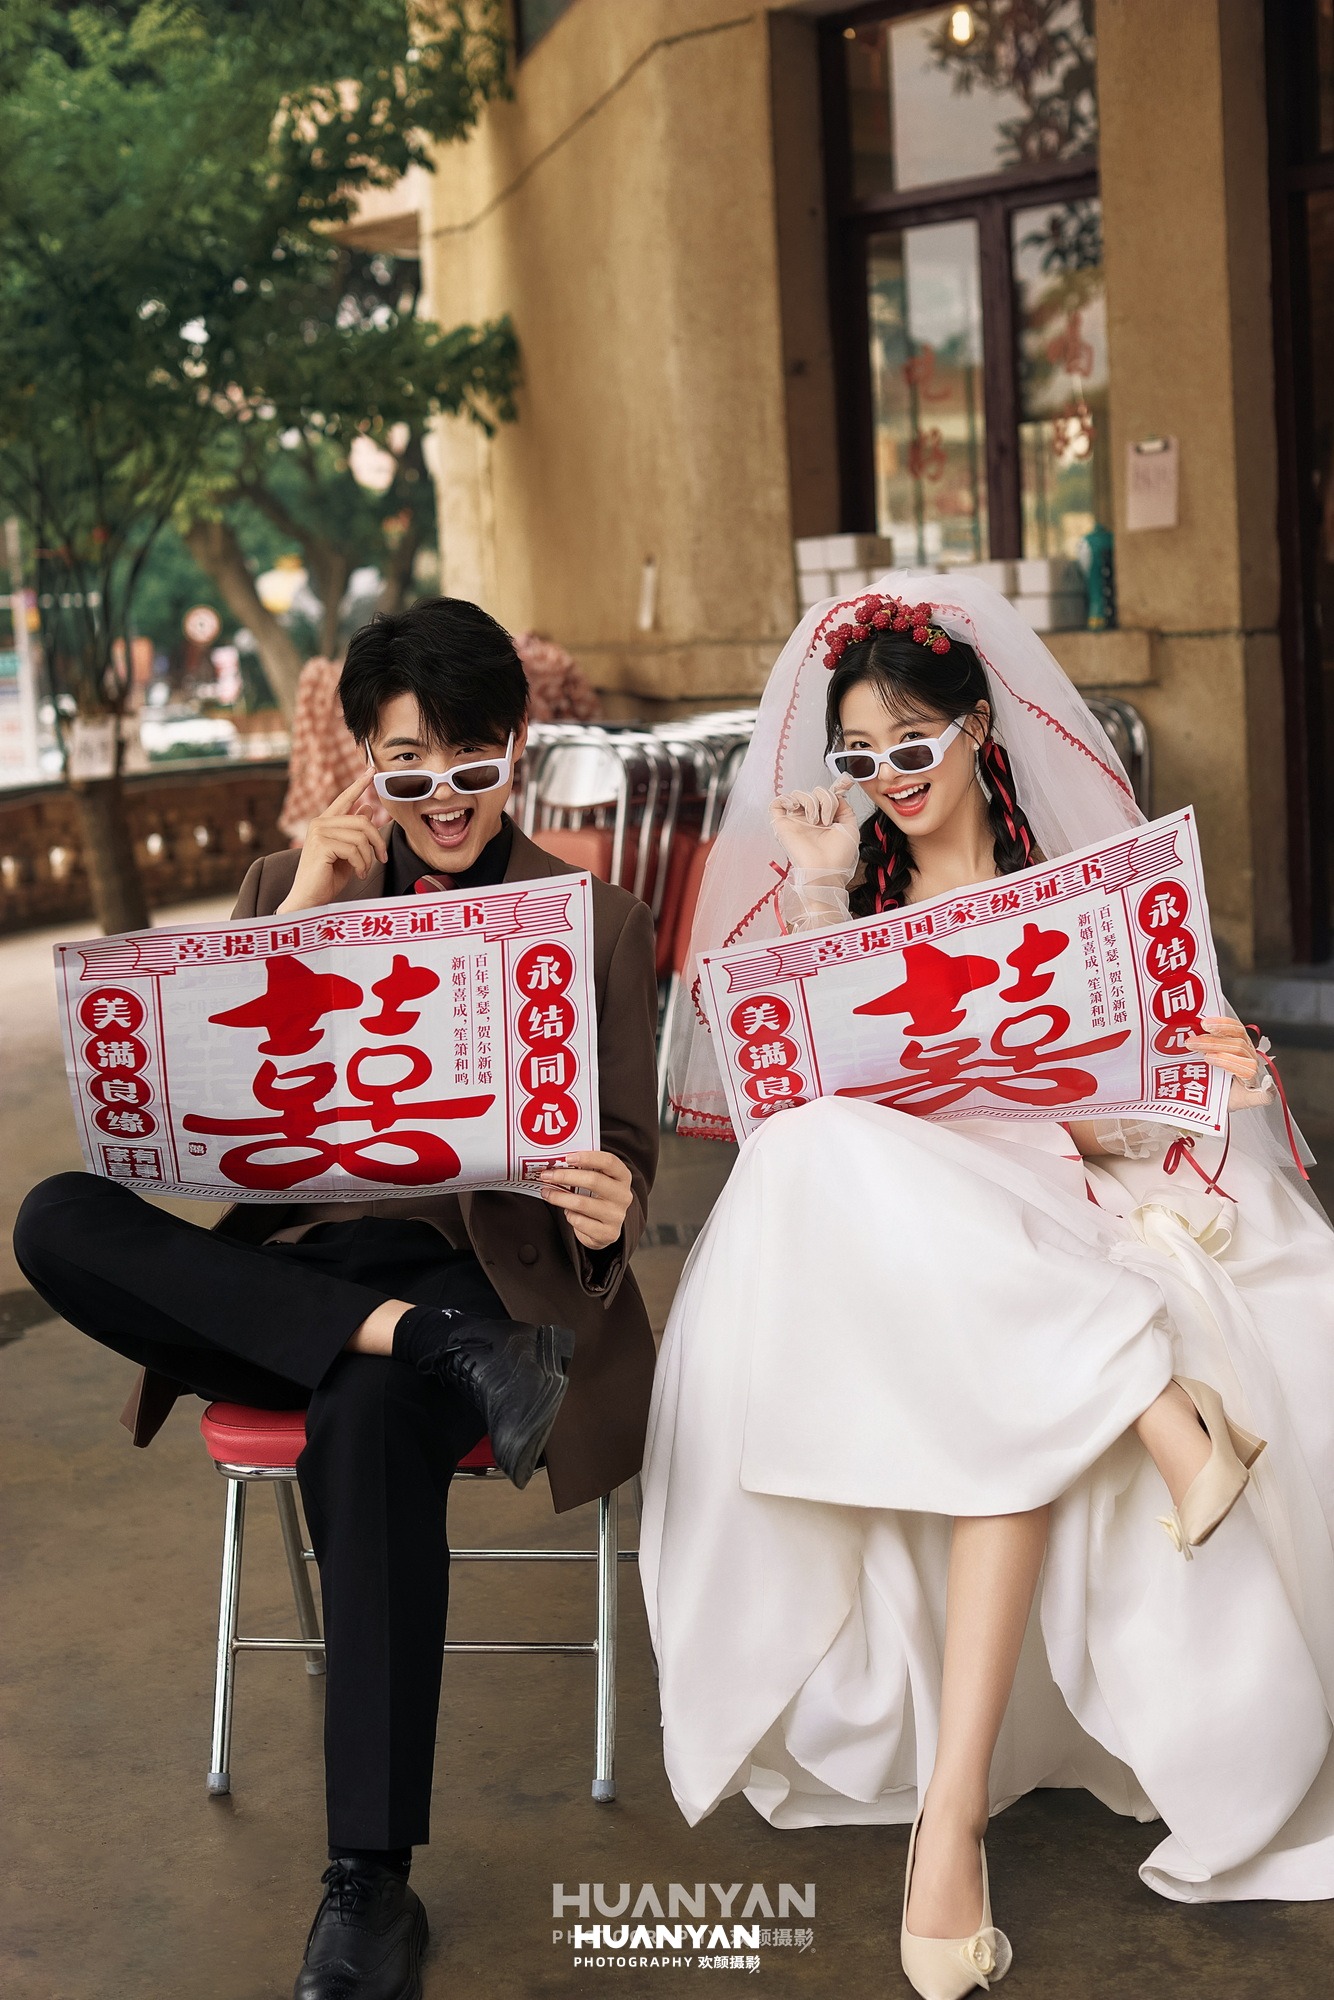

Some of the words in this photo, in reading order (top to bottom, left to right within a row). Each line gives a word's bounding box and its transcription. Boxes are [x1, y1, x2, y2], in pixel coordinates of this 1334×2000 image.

[178, 903, 484, 960] 喜提国家级证书
[818, 859, 1102, 962] 喜提国家级证书
[1148, 892, 1197, 1048] 永结同心
[93, 997, 146, 1133] 美满良缘
[527, 955, 569, 1135] 永结同心
[1157, 1064, 1207, 1084] 百年
[1157, 1081, 1207, 1103] 好合
